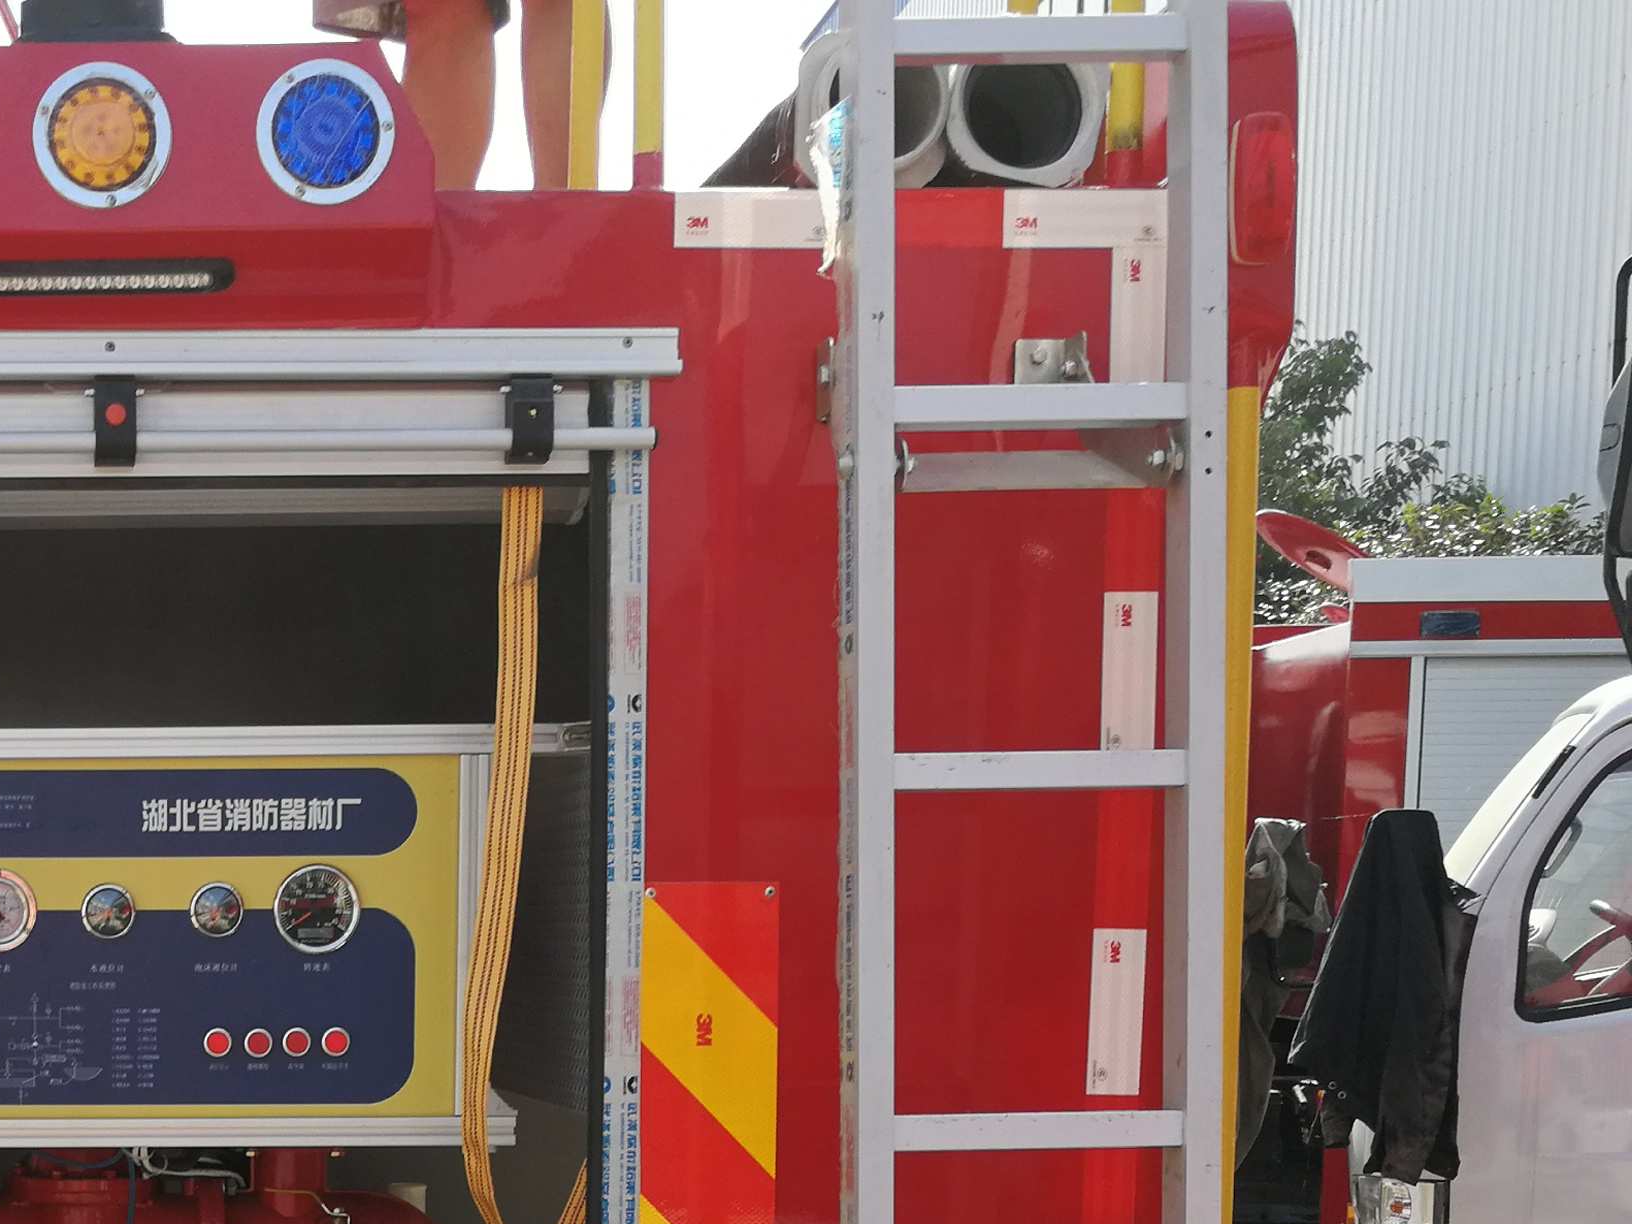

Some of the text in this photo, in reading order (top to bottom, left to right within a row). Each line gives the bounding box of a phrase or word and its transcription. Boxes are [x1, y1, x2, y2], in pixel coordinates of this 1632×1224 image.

[686, 216, 710, 230] 3M
[1014, 216, 1038, 230] 3M
[1130, 258, 1142, 282] 3M
[1121, 603, 1133, 628] 3M
[141, 798, 362, 832] 湖北省消防器材厂
[1110, 940, 1122, 964] 3M
[696, 1013, 713, 1047] 3M
